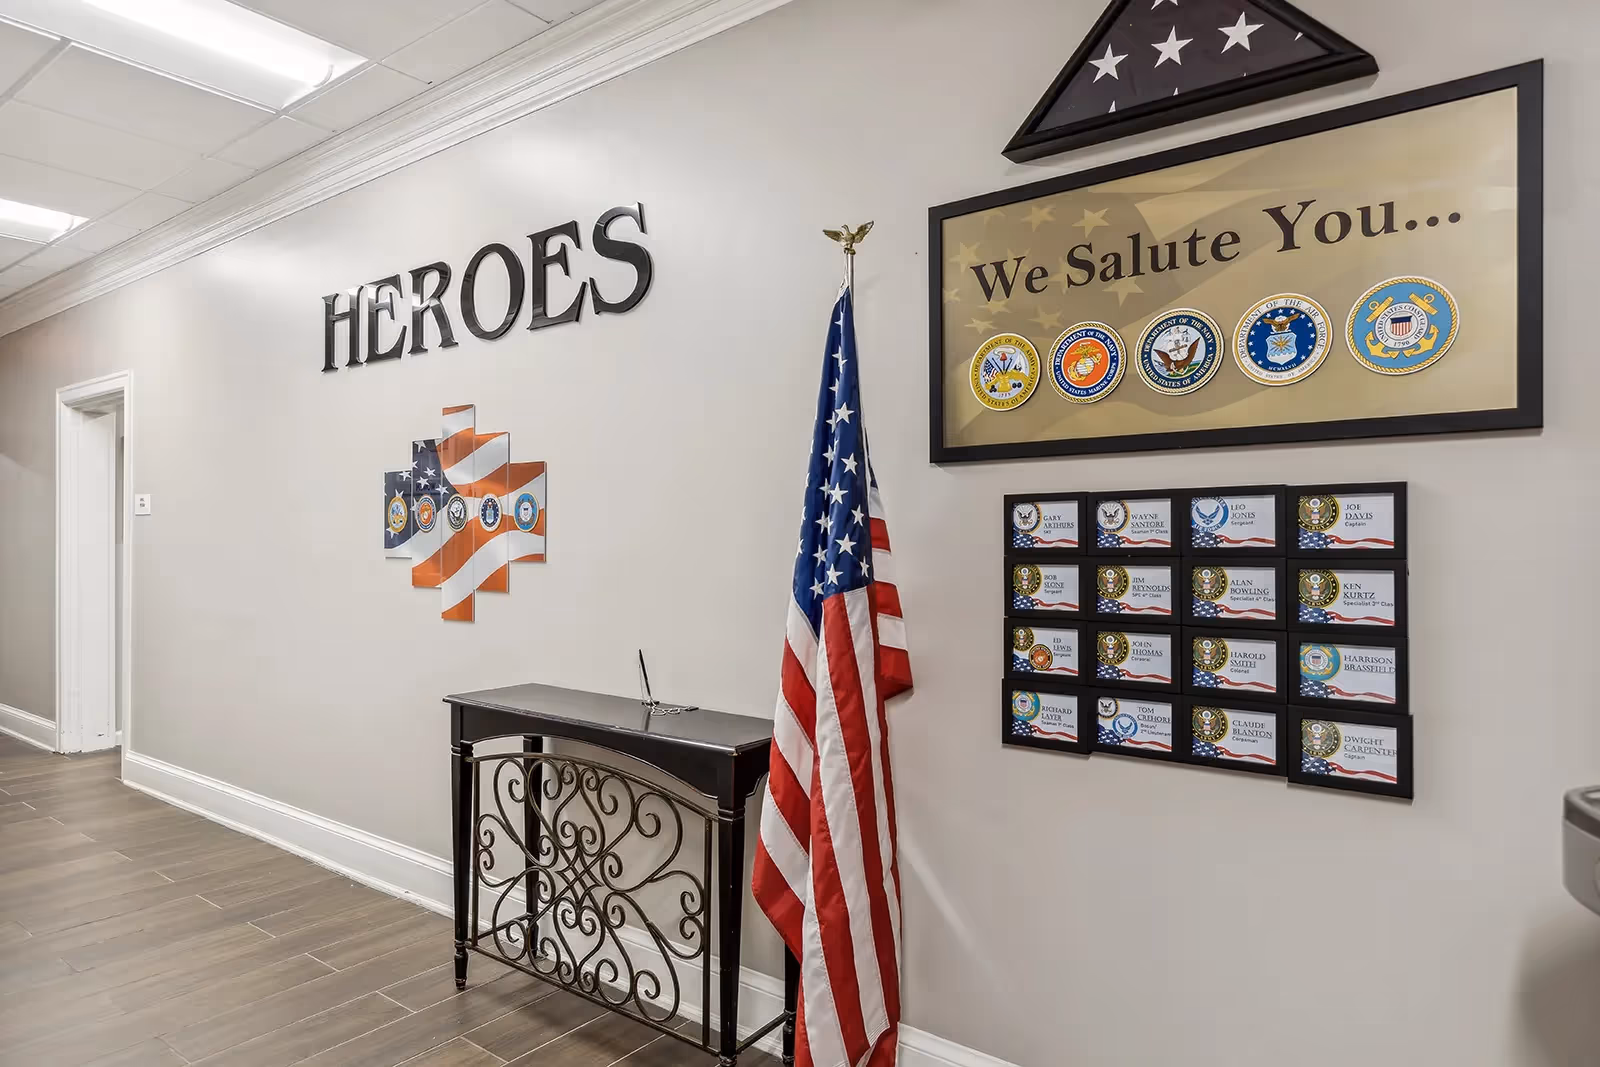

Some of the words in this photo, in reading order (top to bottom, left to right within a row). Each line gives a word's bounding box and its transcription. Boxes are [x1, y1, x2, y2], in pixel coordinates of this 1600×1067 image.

[970, 256, 1048, 302] We
[1066, 228, 1241, 290] Salute
[1262, 200, 1461, 253] You...
[321, 202, 655, 373] HEROES
[1239, 309, 1262, 359] DEPARTMENT
[1284, 299, 1302, 307] THE
[1305, 306, 1319, 319] AIR
[1144, 319, 1176, 352] DEPARTMENT
[1190, 319, 1203, 330] THE
[1202, 327, 1214, 343] NAVY
[1055, 330, 1086, 365] DEPARTMENT
[1095, 331, 1106, 340] THE
[1105, 339, 1117, 356] NAVY
[975, 340, 1001, 371] DEPARTMENT
[1015, 340, 1026, 349] THE
[1026, 350, 1036, 367] ARMY
[1143, 359, 1158, 381] UNITED
[1157, 378, 1181, 387] STATES
[1193, 353, 1213, 381] AMERICA
[987, 397, 1009, 406] STATES
[1019, 370, 1036, 399] AMERICA
[1069, 386, 1087, 395] STATES
[1230, 652, 1266, 660] HAROLD
[1344, 655, 1393, 664] HARRISON
[1230, 660, 1256, 668] SMITH
[1042, 706, 1072, 714] RICHARD
[1041, 713, 1062, 721] LAYER
[1232, 720, 1265, 728] CLAUDE
[1232, 728, 1272, 739] BLANTON
[1344, 736, 1384, 746] DWIGHT
